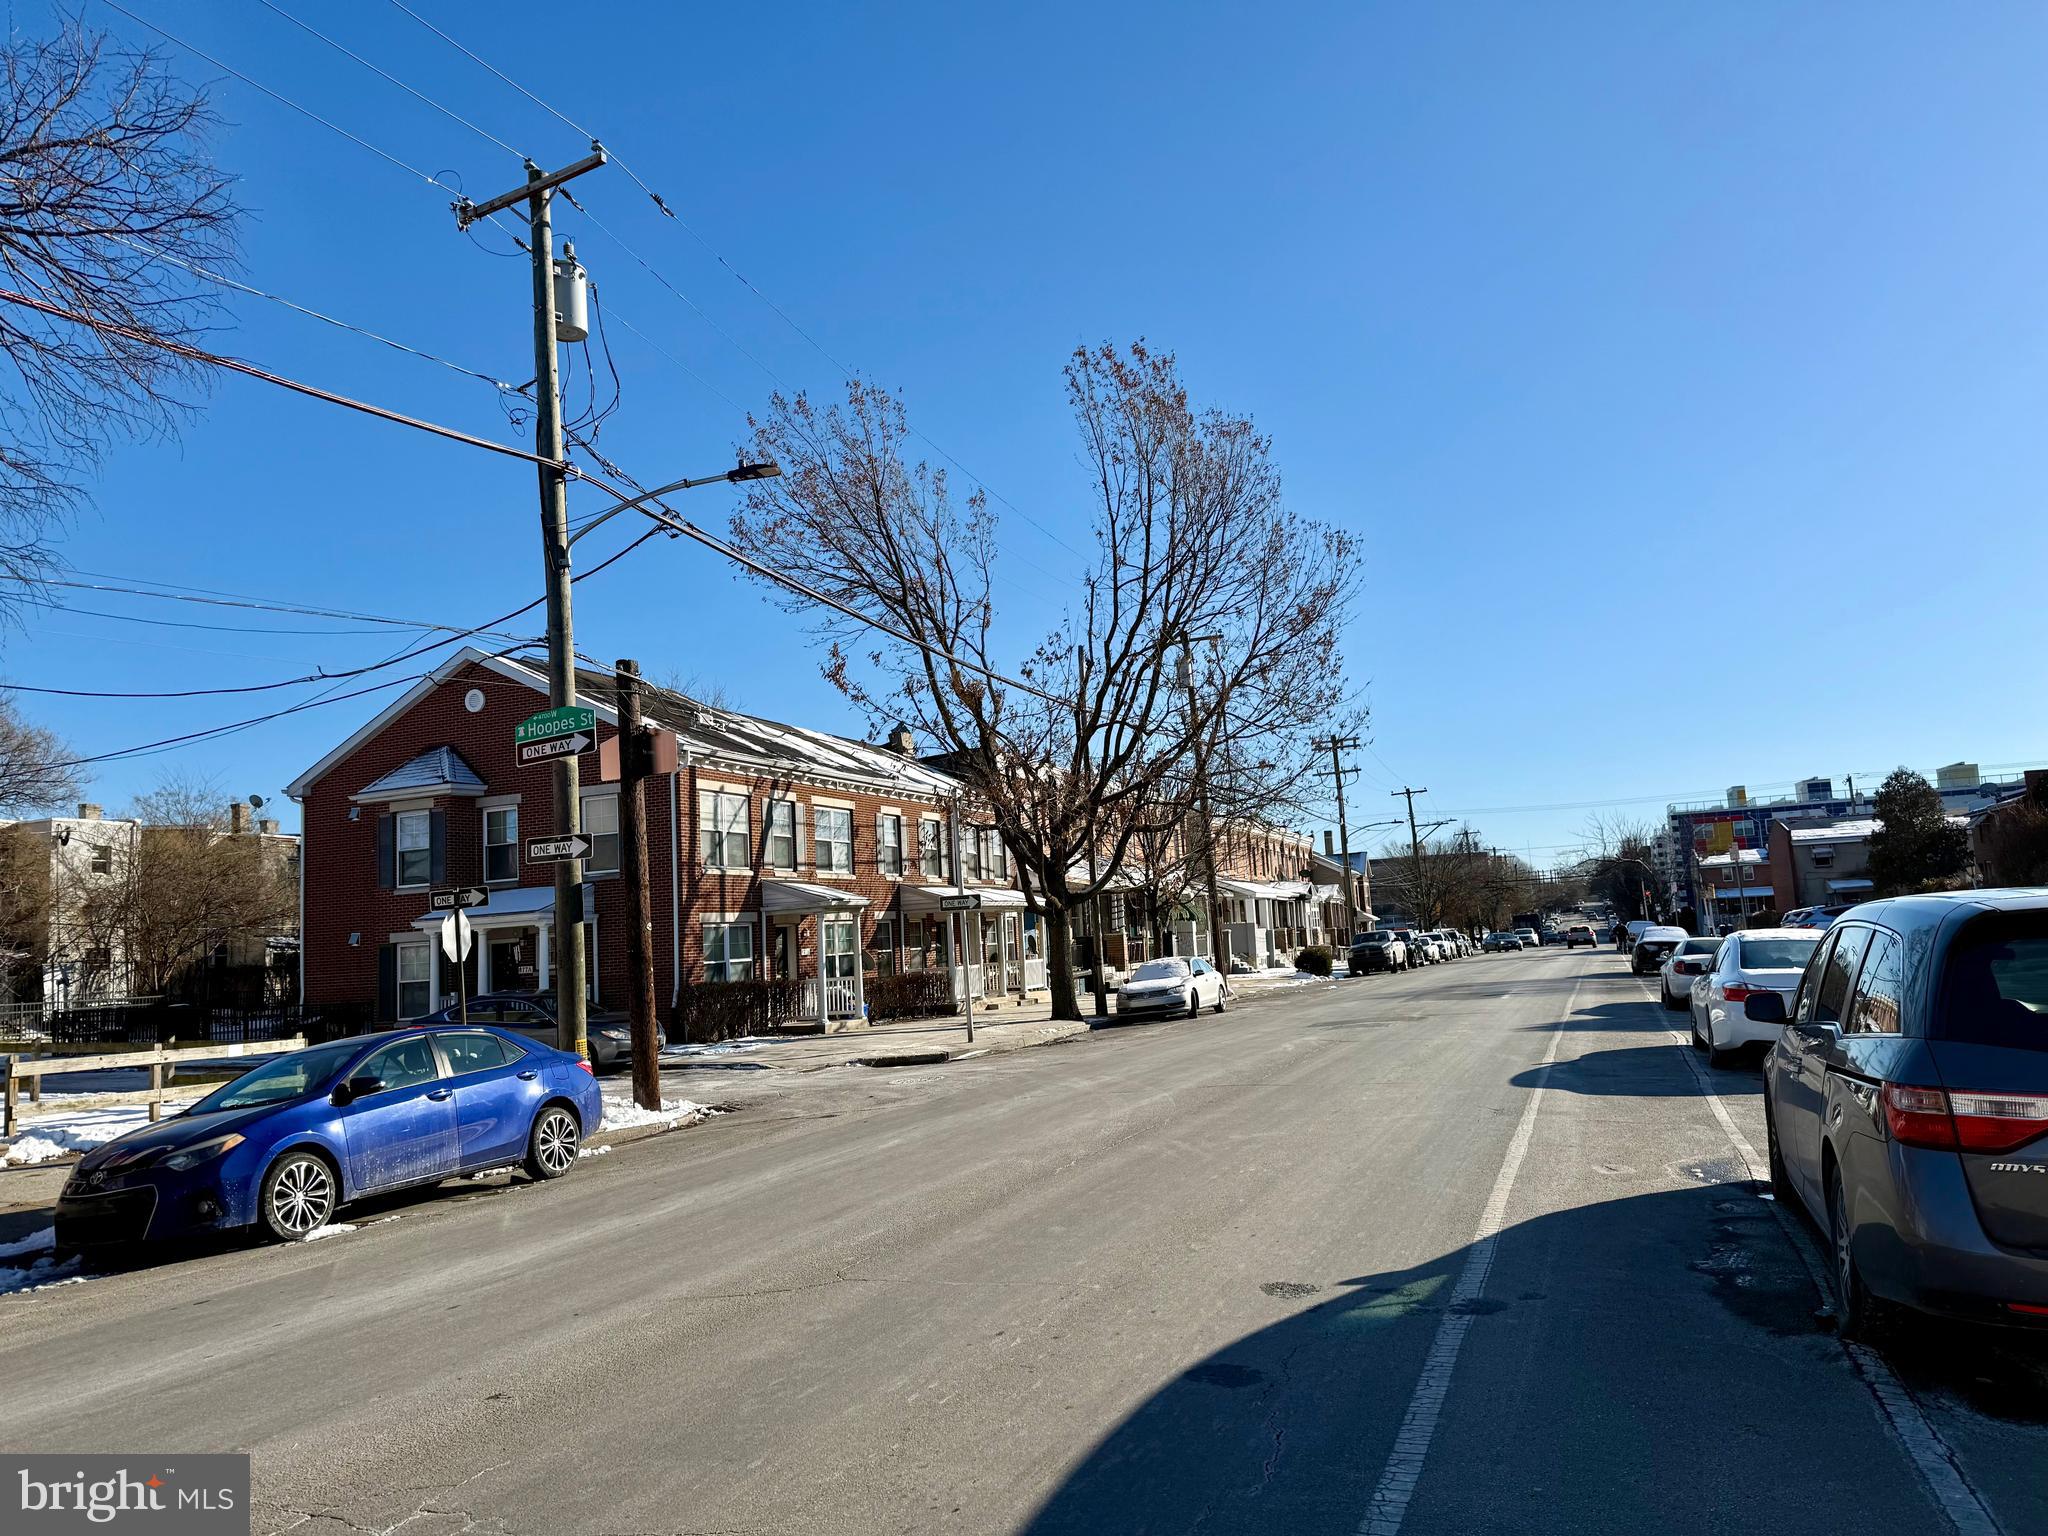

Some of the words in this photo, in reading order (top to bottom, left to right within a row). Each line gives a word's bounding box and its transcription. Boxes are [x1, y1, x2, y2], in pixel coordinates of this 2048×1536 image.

[528, 717, 575, 737] Hoopes
[580, 712, 593, 726] St
[526, 744, 547, 757] ONE
[549, 739, 572, 753] WAY
[533, 844, 551, 856] ONE
[554, 842, 573, 853] WAY
[436, 895, 452, 905] ONE
